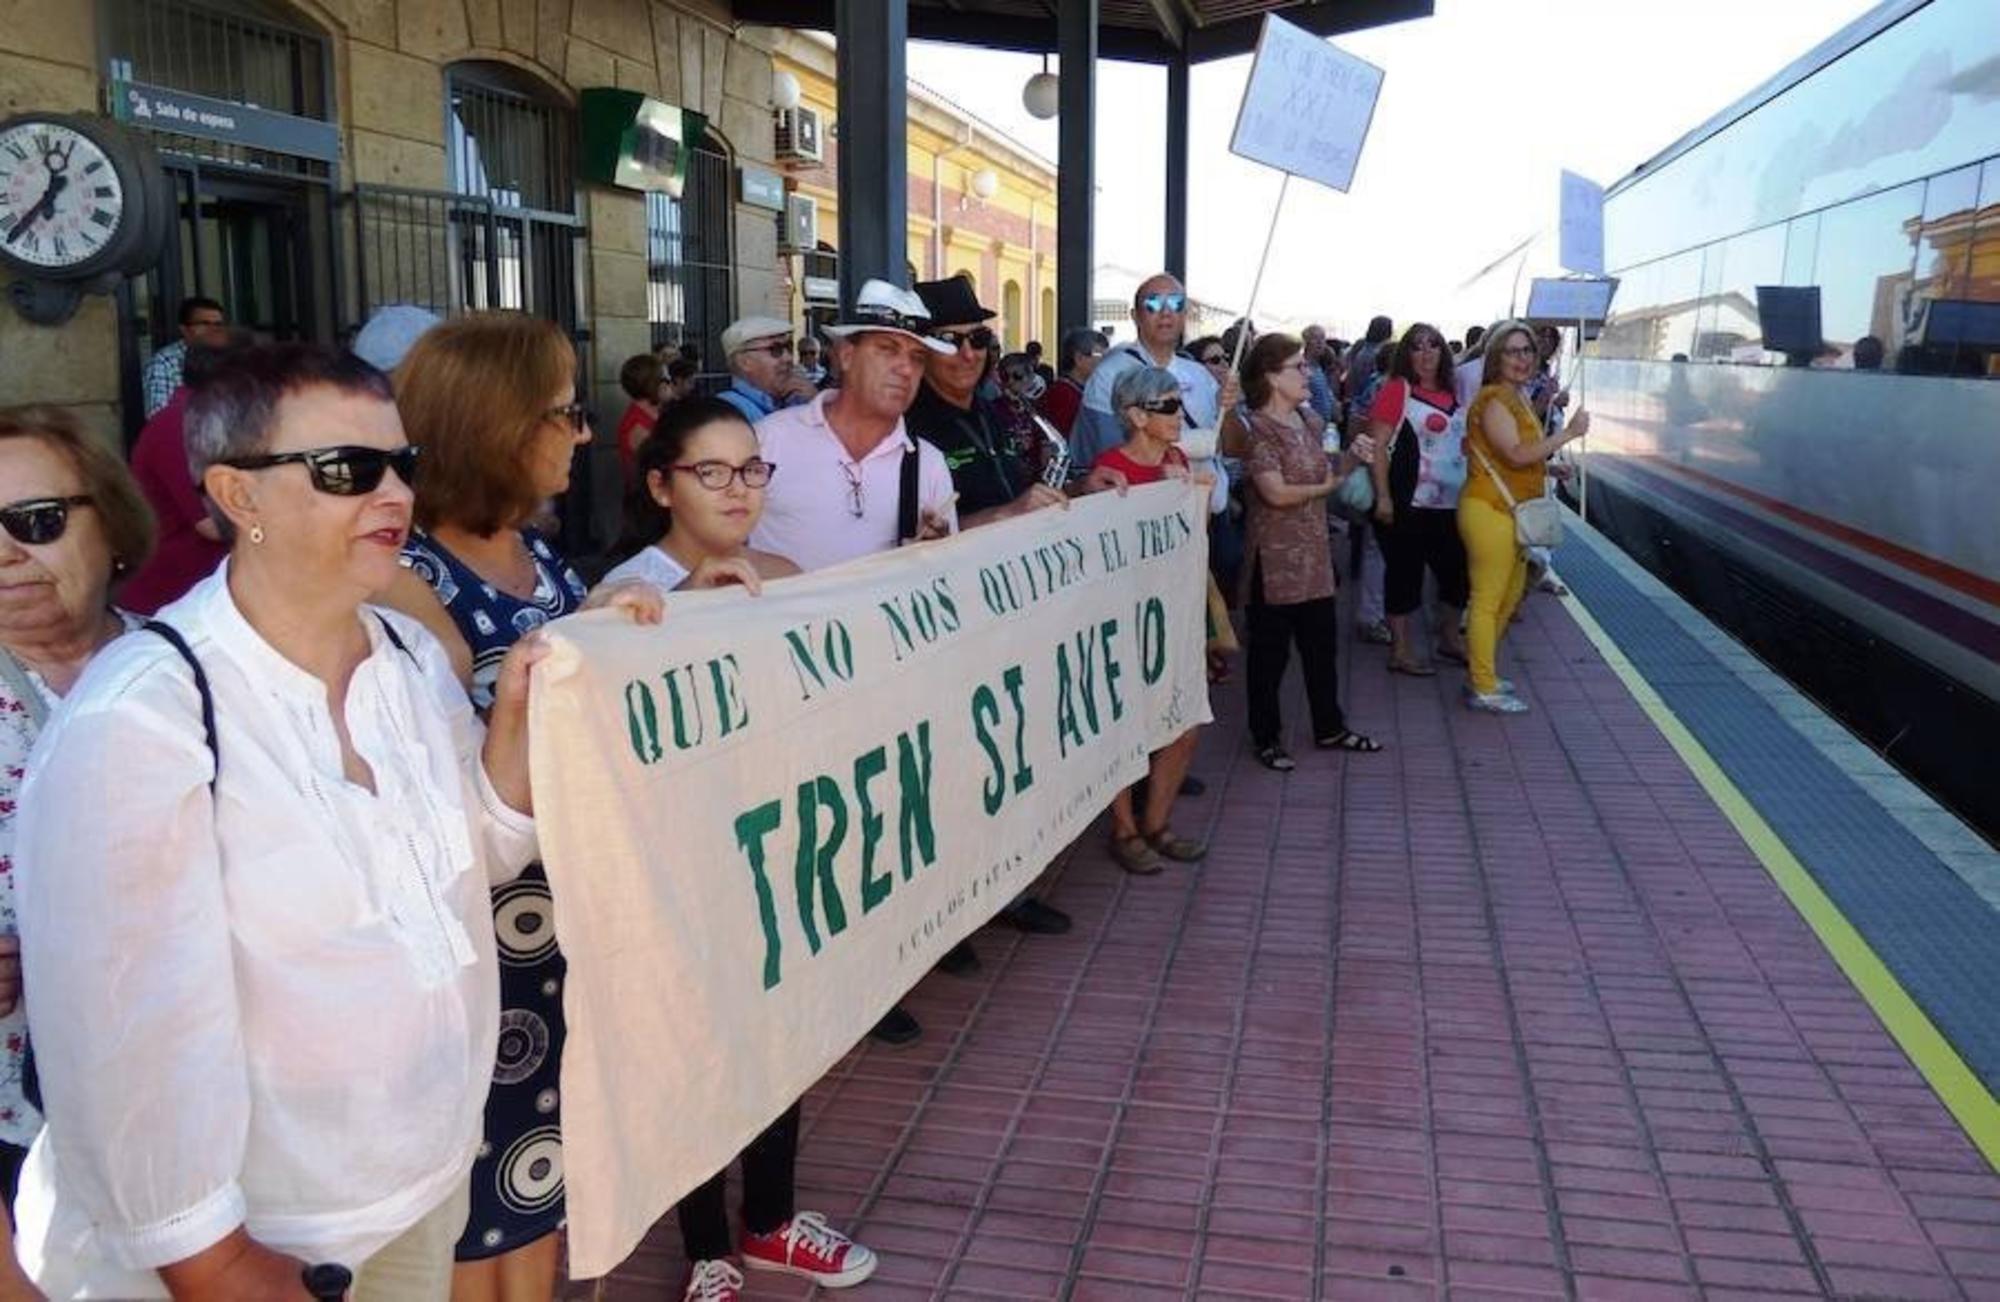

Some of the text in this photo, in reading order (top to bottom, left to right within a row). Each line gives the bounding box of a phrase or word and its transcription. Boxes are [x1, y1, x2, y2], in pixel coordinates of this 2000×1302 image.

[155, 101, 180, 119] Sala
[182, 107, 197, 122] de
[625, 510, 1191, 765] QUE NO NOS QUITEN EL TREN
[734, 719, 936, 992] TREN
[971, 665, 1034, 817] SI
[1056, 619, 1124, 759] AVE
[1135, 596, 1166, 686] O
